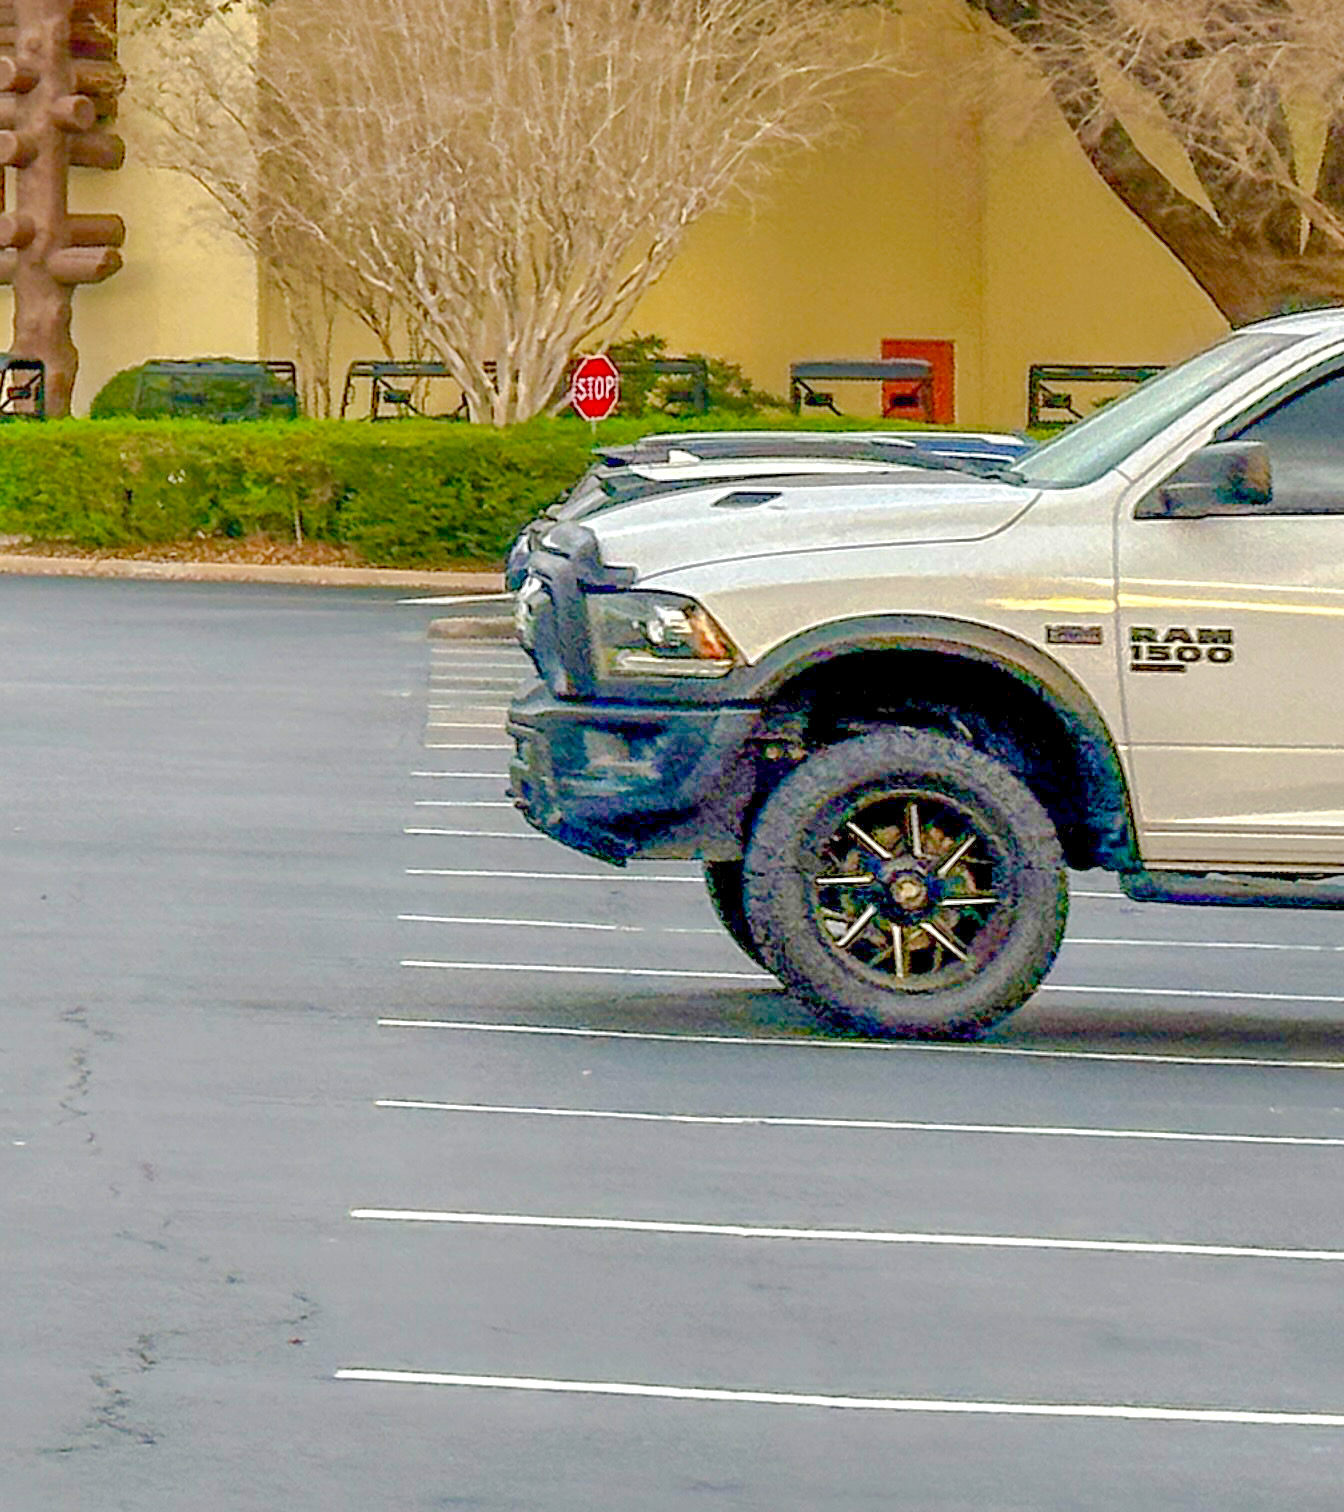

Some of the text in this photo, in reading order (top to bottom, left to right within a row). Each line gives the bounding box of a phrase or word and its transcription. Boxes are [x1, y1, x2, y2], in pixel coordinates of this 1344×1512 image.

[577, 375, 615, 402] STOP
[1130, 626, 1233, 644] RAM
[1131, 645, 1233, 662] 1500
